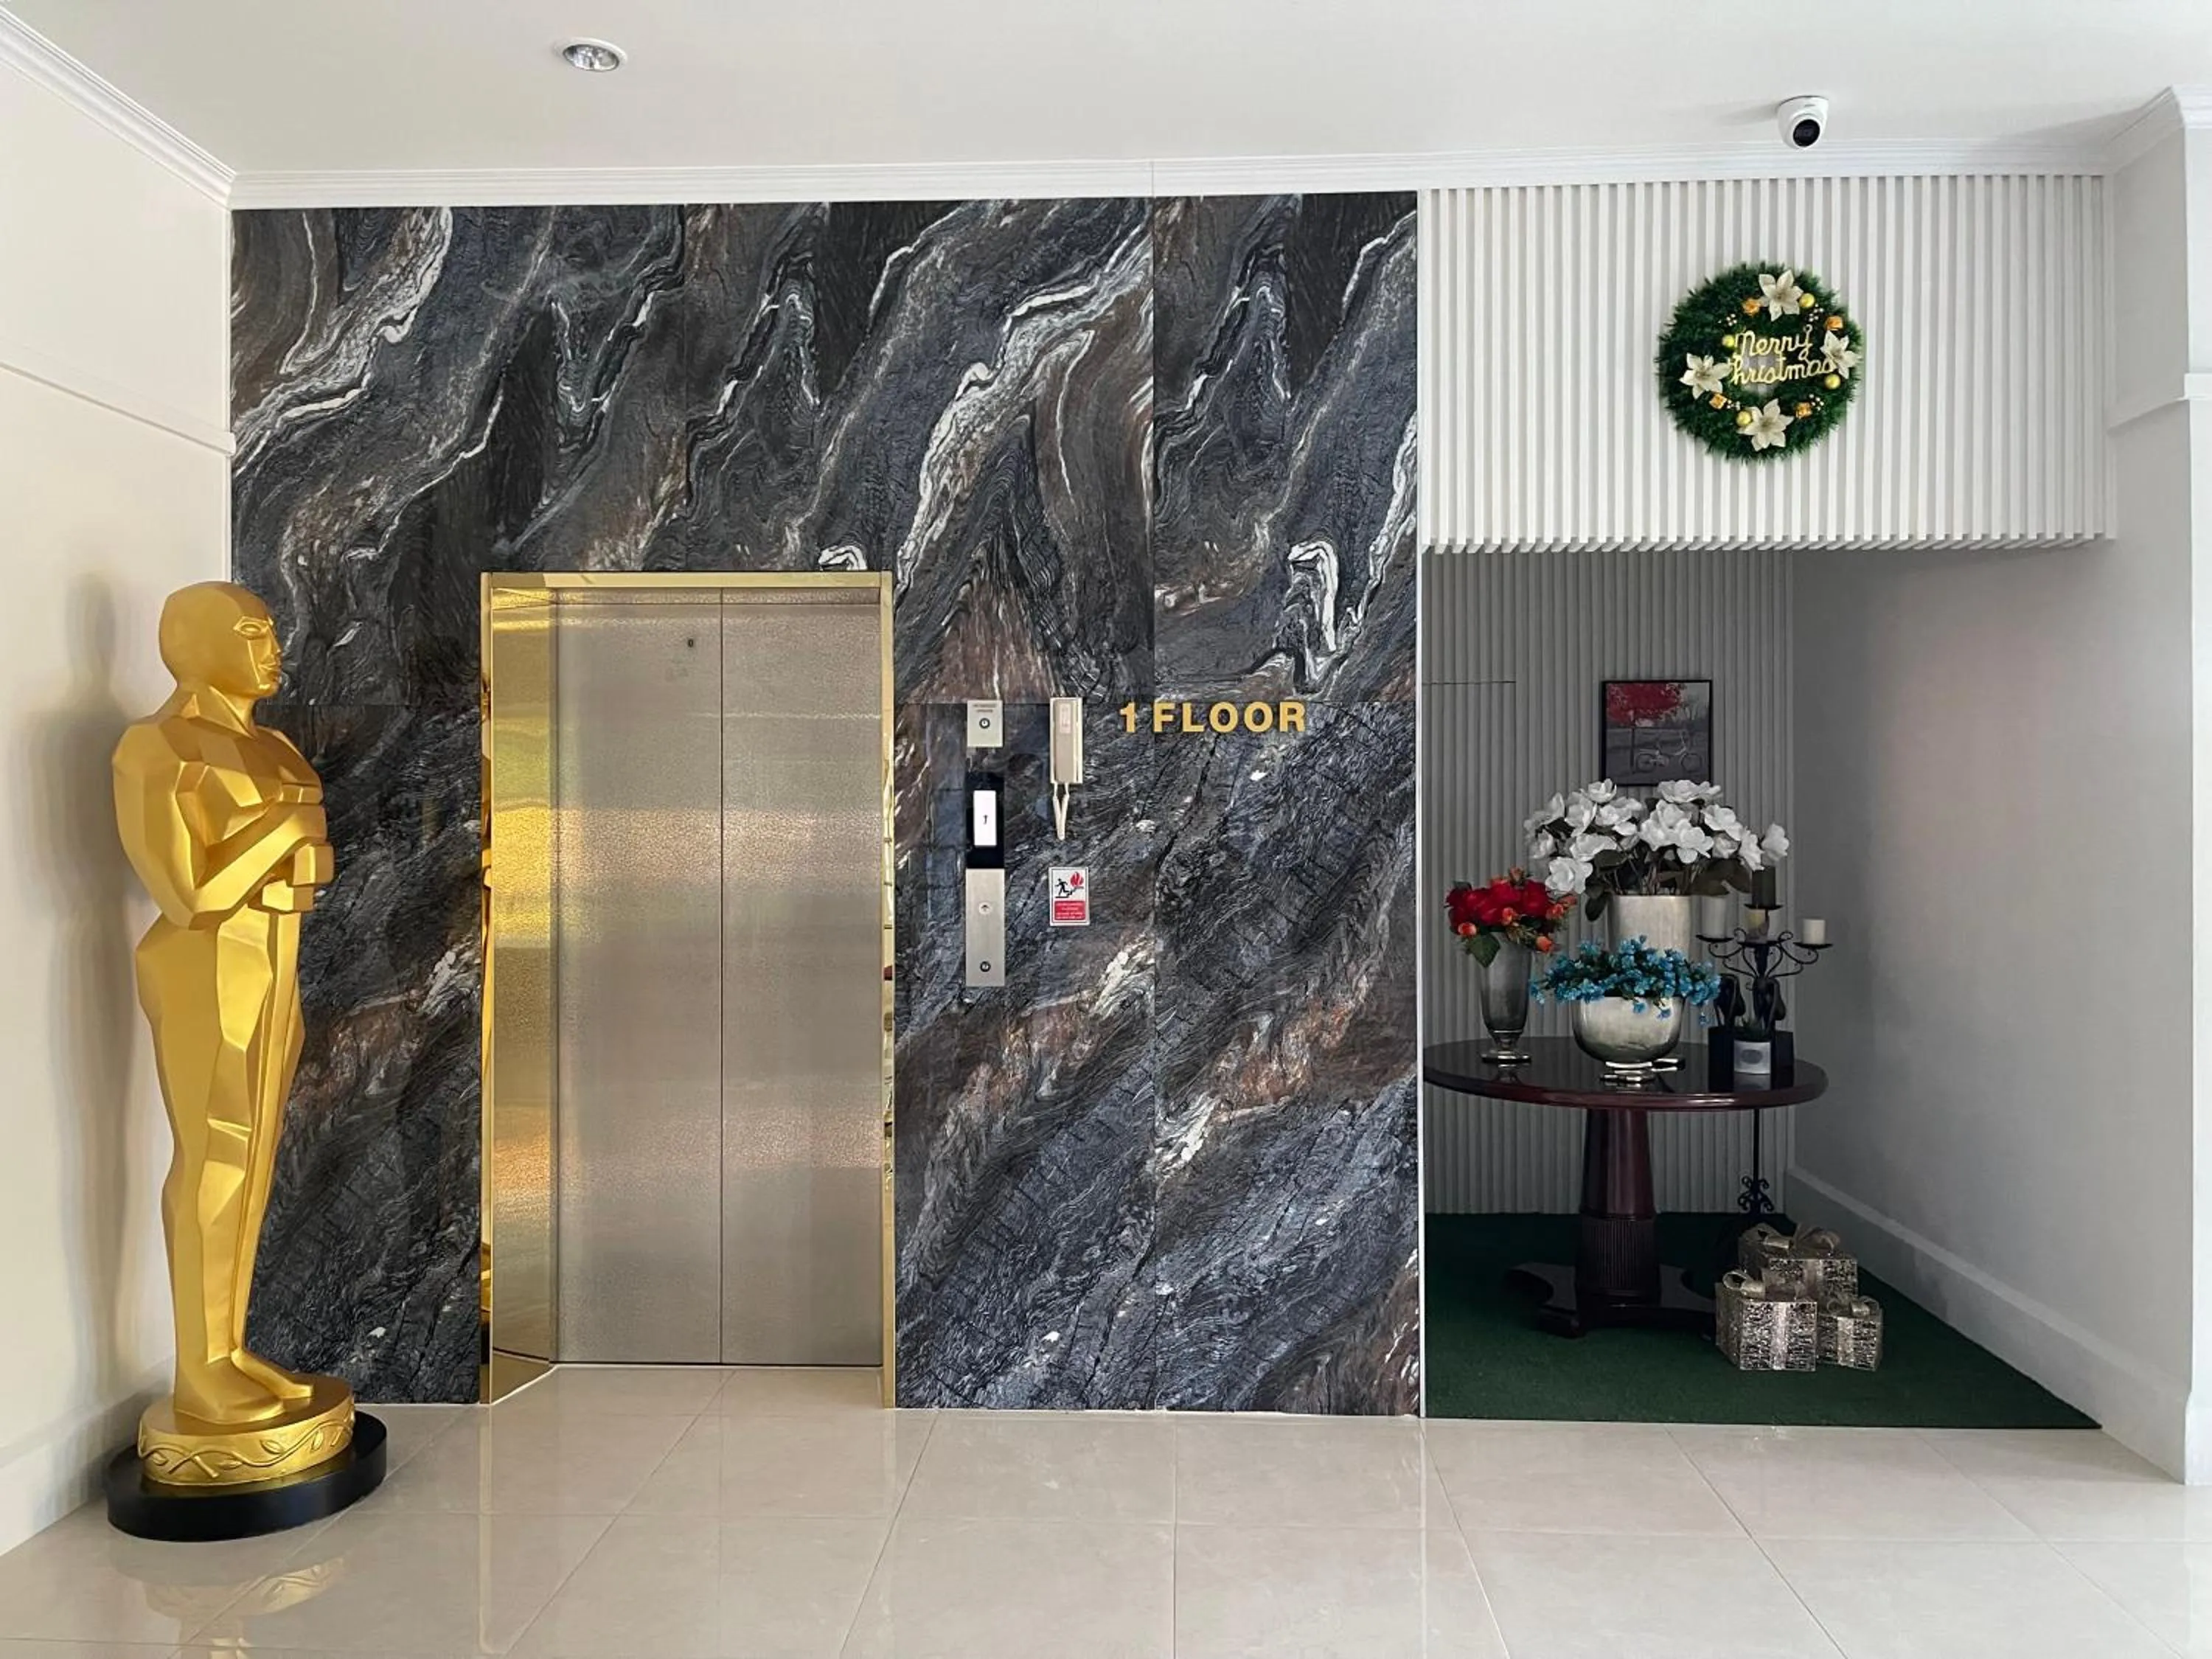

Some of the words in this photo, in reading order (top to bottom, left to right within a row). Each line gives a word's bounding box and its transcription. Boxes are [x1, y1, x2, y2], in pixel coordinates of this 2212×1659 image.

[1735, 324, 1813, 361] Merry
[1728, 352, 1836, 385] hristmas
[1120, 702, 1136, 733] 1
[1153, 702, 1306, 733] FLOOR
